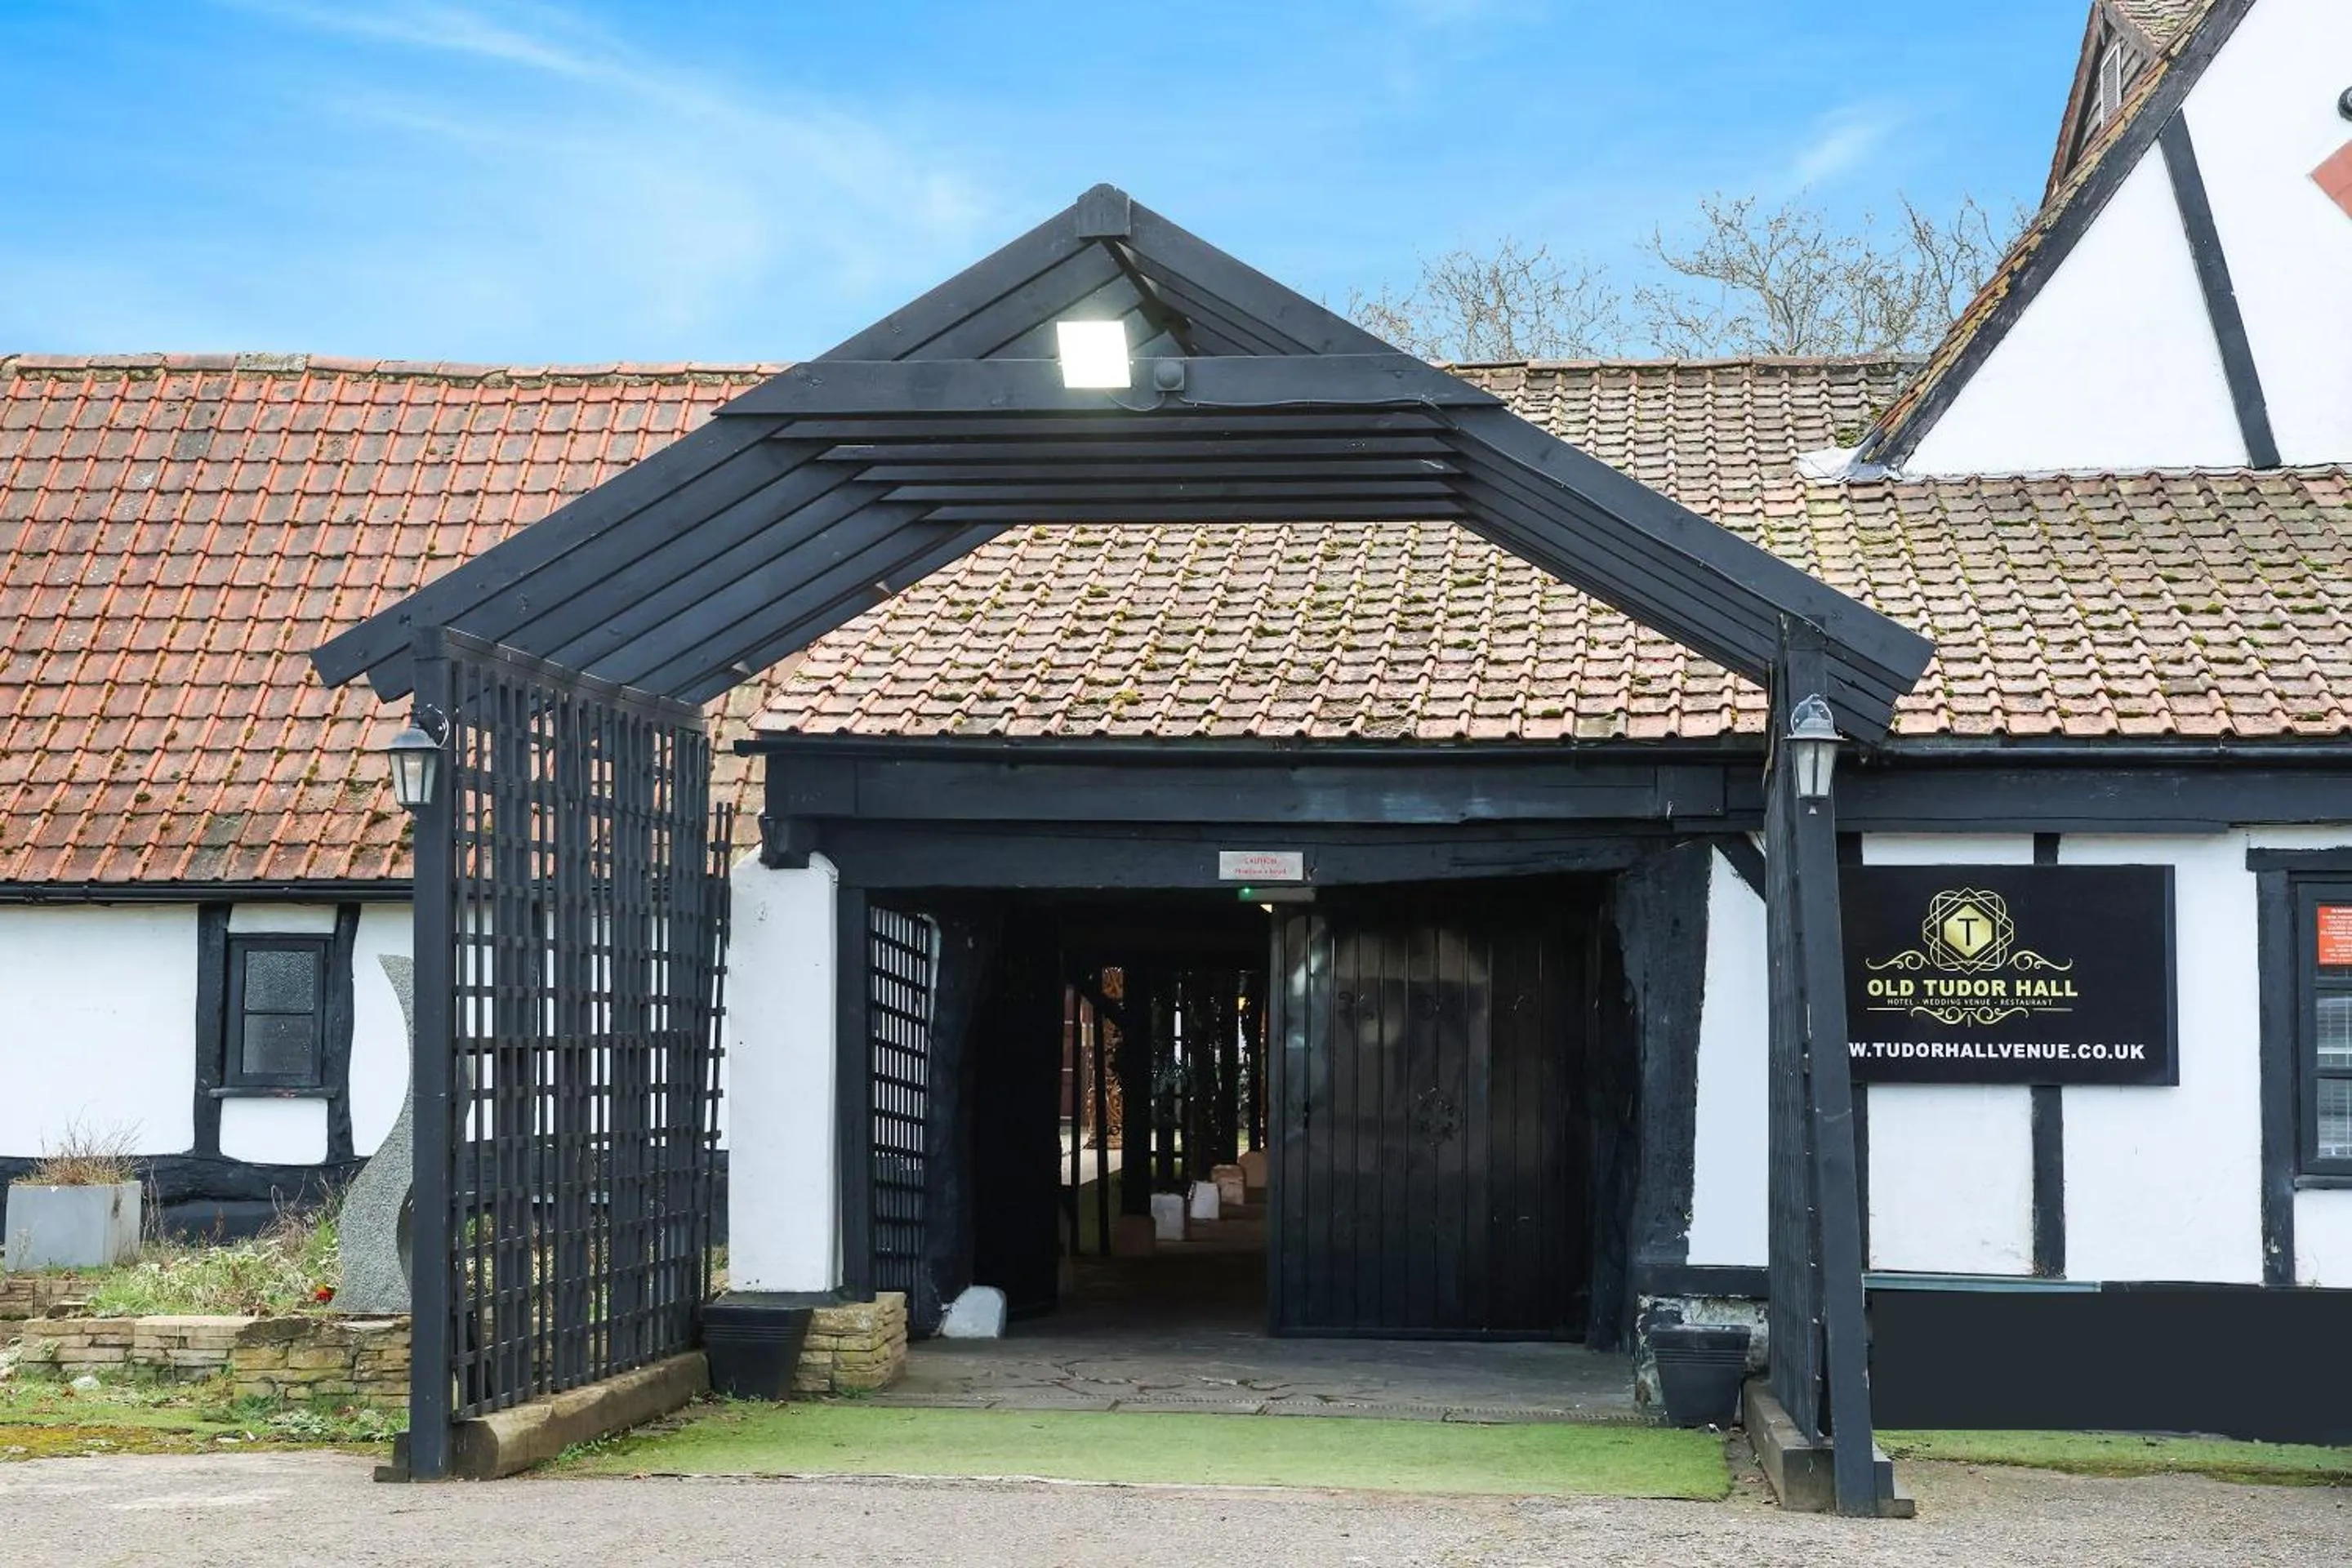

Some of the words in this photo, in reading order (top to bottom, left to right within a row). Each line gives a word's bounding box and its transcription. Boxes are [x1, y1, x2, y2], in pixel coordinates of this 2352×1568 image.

[1957, 918, 1980, 947] T
[1867, 979, 1915, 996] OLD
[1923, 979, 2007, 996] TUDOR
[2016, 979, 2078, 996] HALL
[1886, 998, 1914, 1006] HOTEL
[1922, 998, 1961, 1006] WEDDING
[1964, 998, 1990, 1006] VENUE
[1848, 1042, 2145, 1059] W.TUDORHALLVENUE.CO.UK
